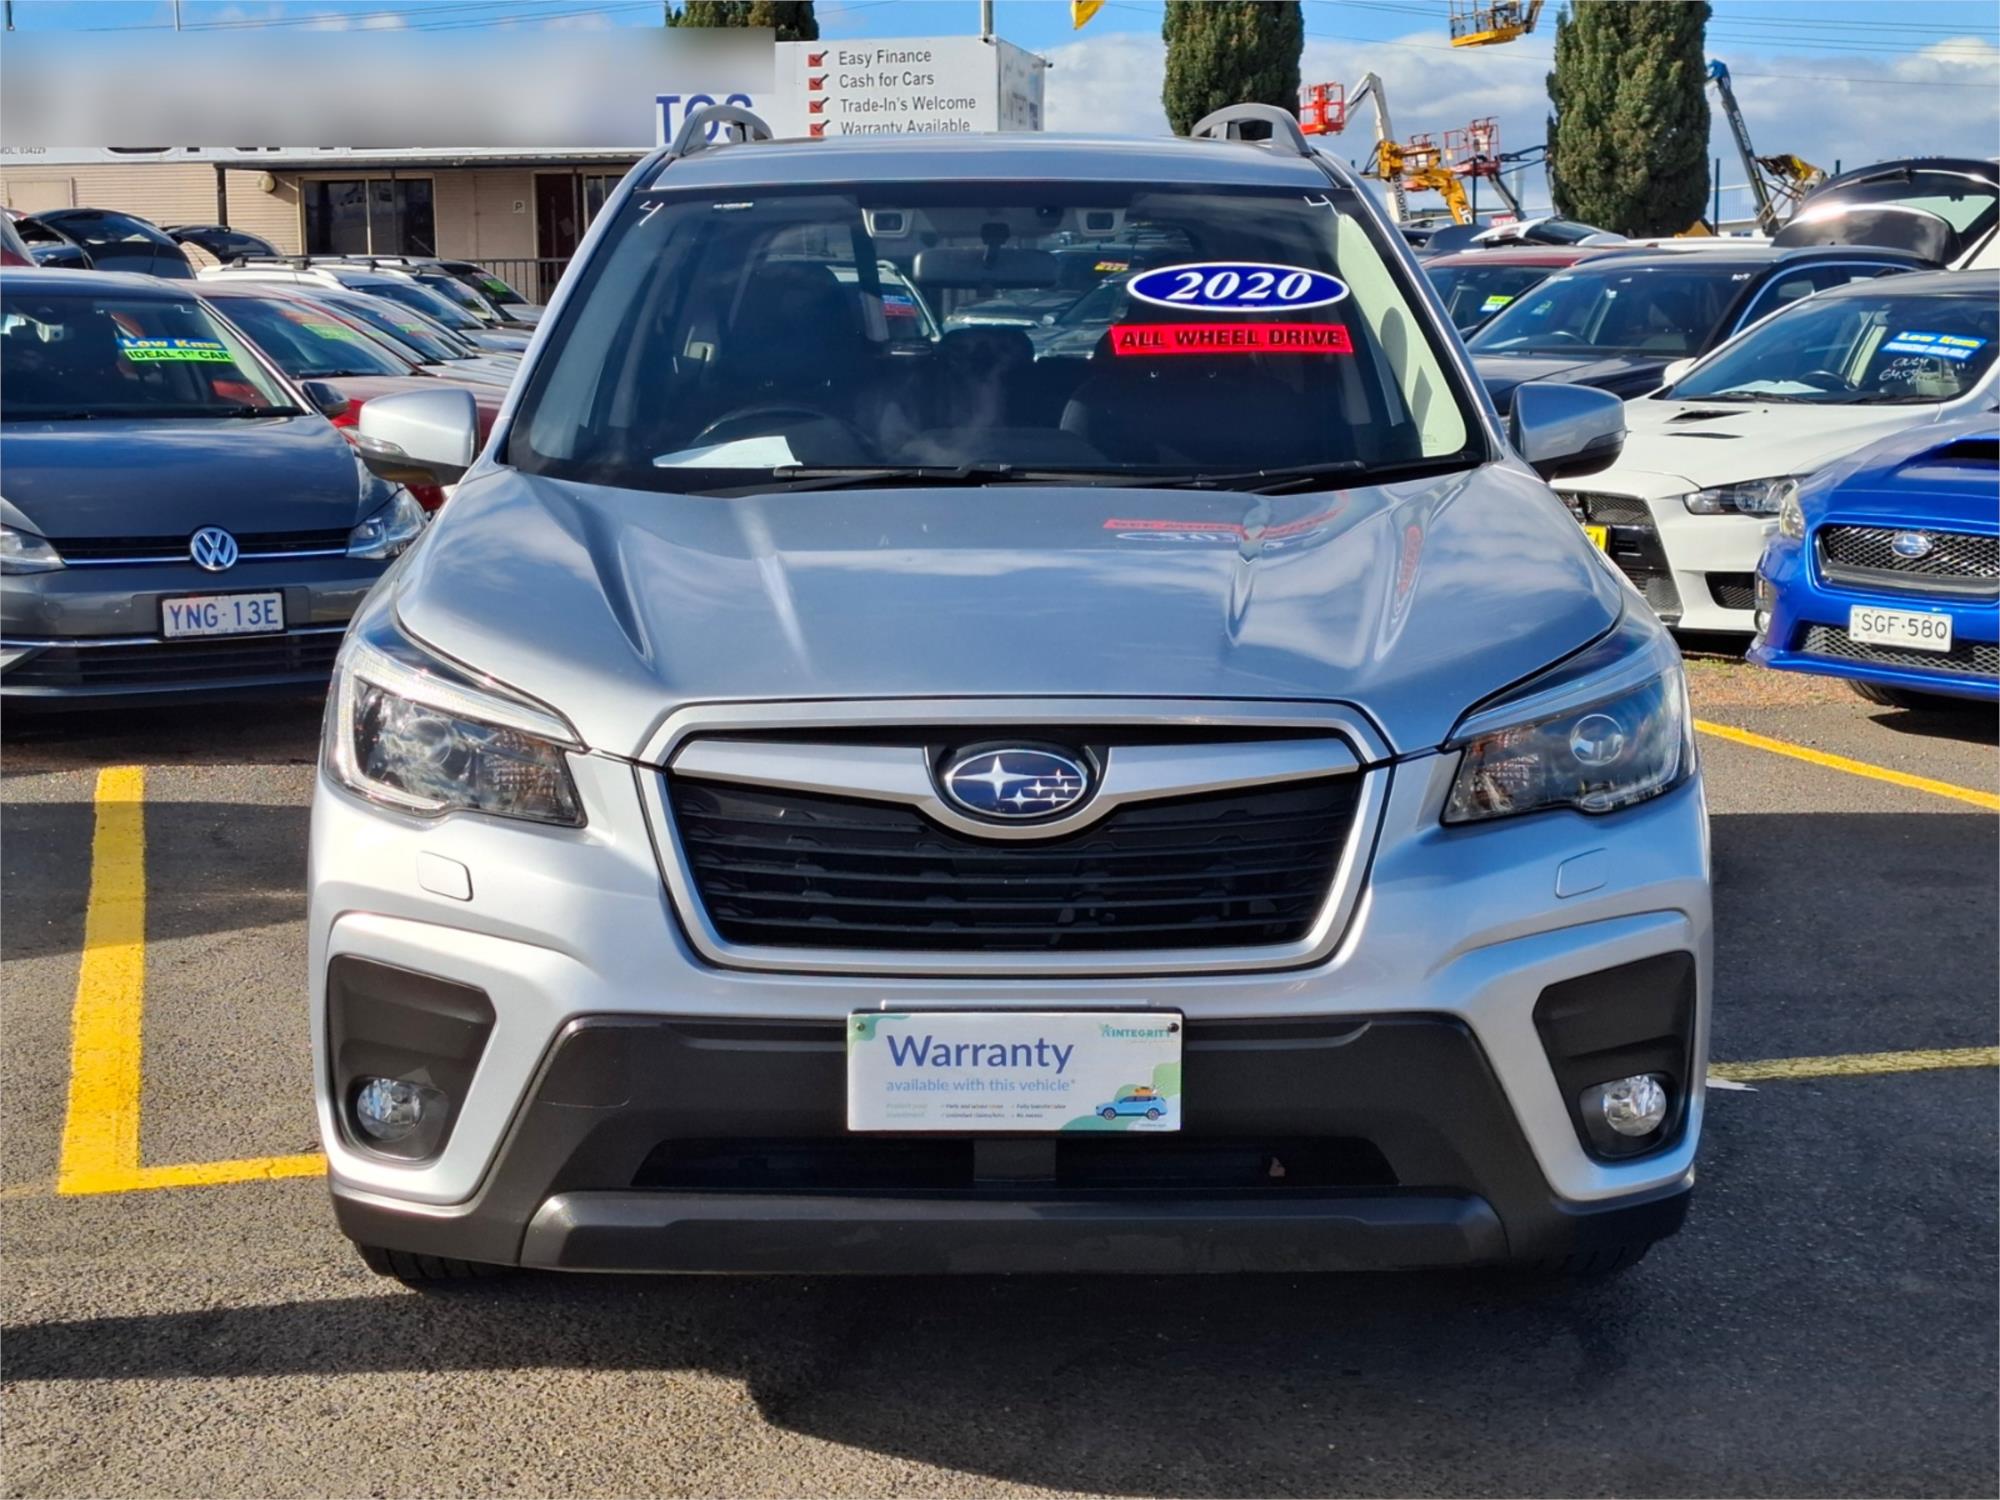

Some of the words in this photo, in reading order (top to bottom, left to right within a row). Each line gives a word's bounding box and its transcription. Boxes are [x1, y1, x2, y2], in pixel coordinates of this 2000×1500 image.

[838, 50, 873, 69] Easy
[876, 49, 932, 65] Finance
[839, 73, 875, 88] Cash
[878, 72, 899, 87] for
[902, 71, 935, 86] Cars
[840, 97, 909, 113] Trade-In's
[911, 96, 977, 111] Welcome
[840, 120, 903, 136] Warranty
[907, 118, 971, 133] Available
[1165, 270, 1313, 301] 2020
[1120, 329, 1165, 347] ALL
[1174, 329, 1262, 347] WHEEL
[1268, 328, 1346, 346] DRIVE
[127, 349, 176, 360] IDEAL
[199, 350, 232, 360] CAR
[886, 1034, 1075, 1075] Warranty
[886, 1078, 950, 1092] available
[952, 1078, 986, 1092] with
[989, 1078, 1016, 1092] this
